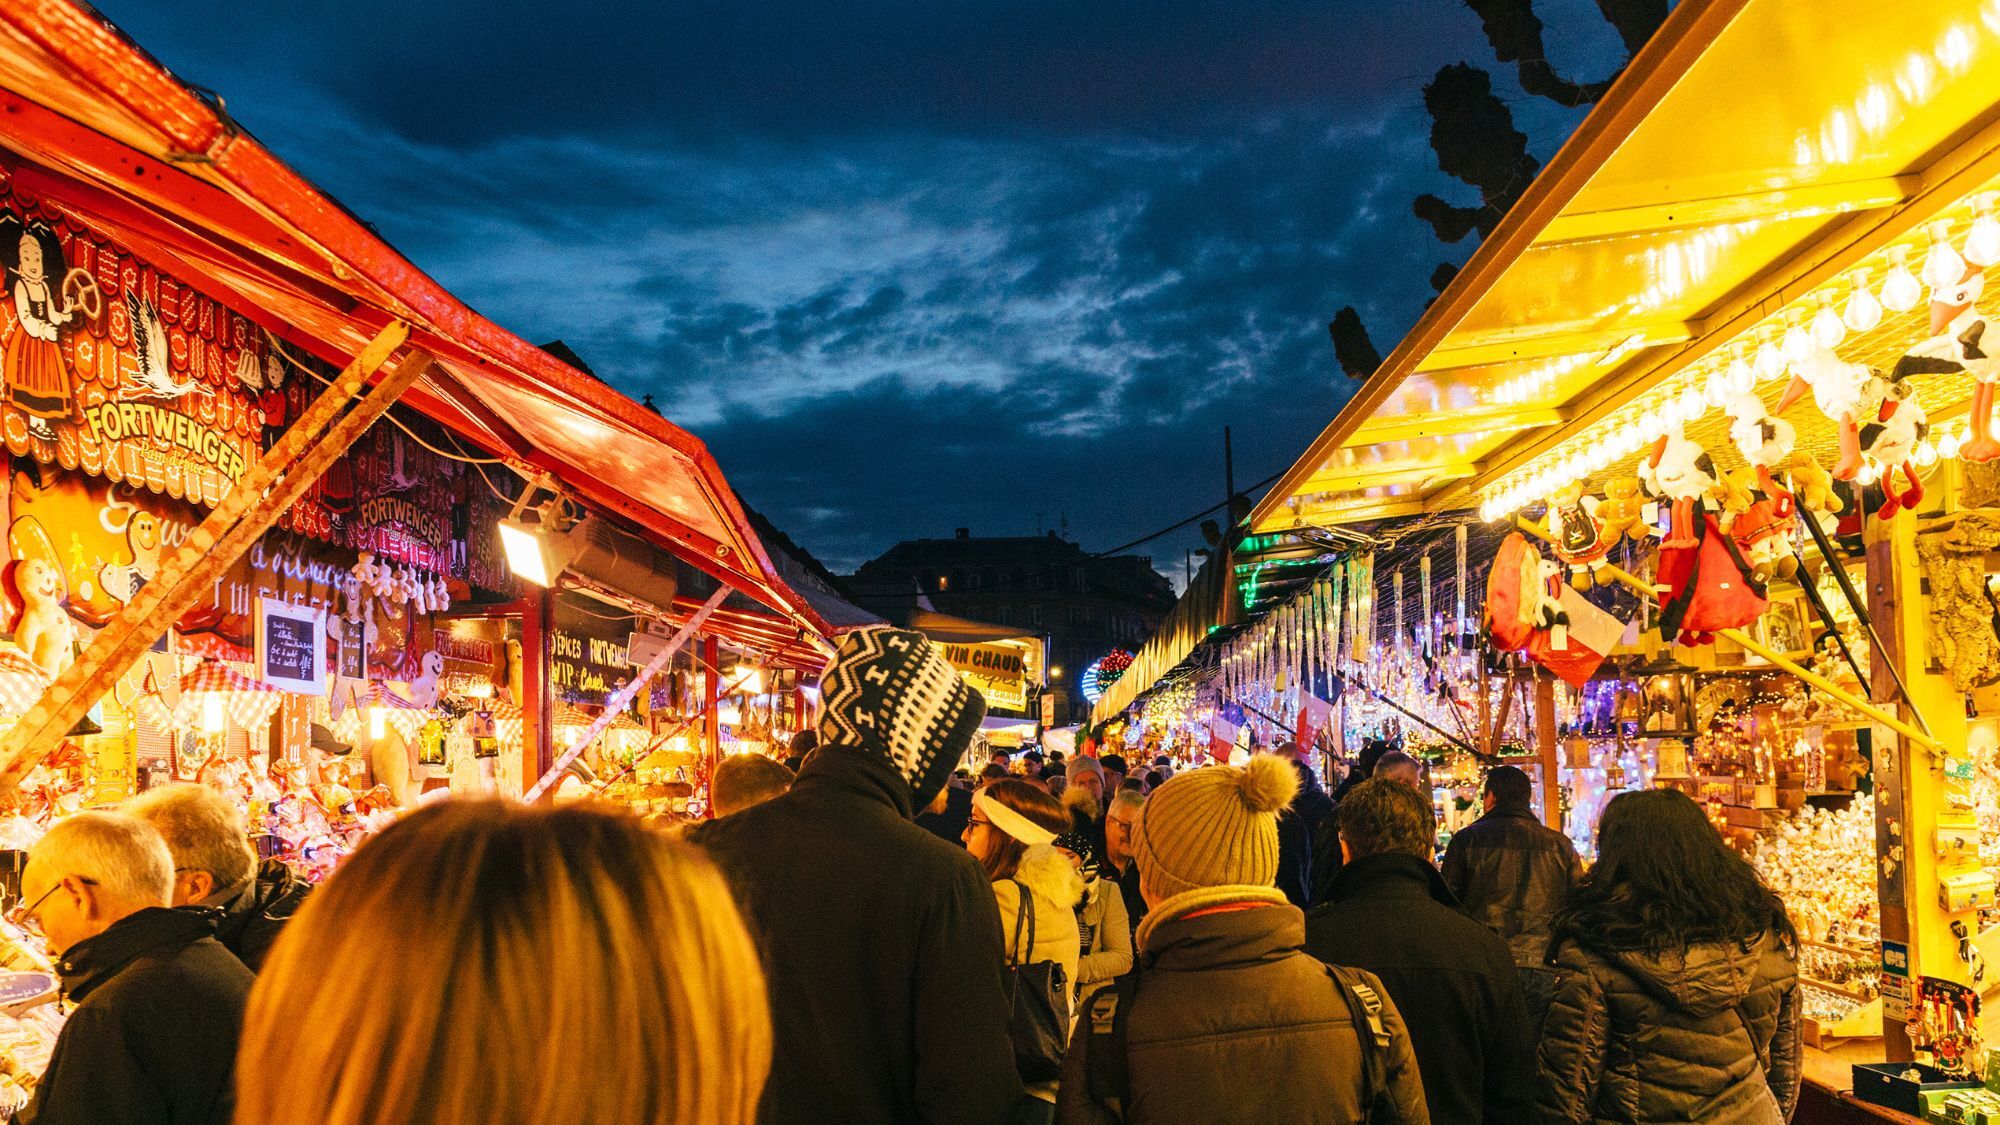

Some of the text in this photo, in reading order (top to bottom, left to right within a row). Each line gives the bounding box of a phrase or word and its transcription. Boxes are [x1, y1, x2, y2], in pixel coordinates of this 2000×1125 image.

[85, 402, 246, 486] FORTWENGER
[140, 441, 166, 464] Pain
[361, 498, 442, 552] FORTWENGER
[945, 645, 1021, 673] VIN CHAUD
